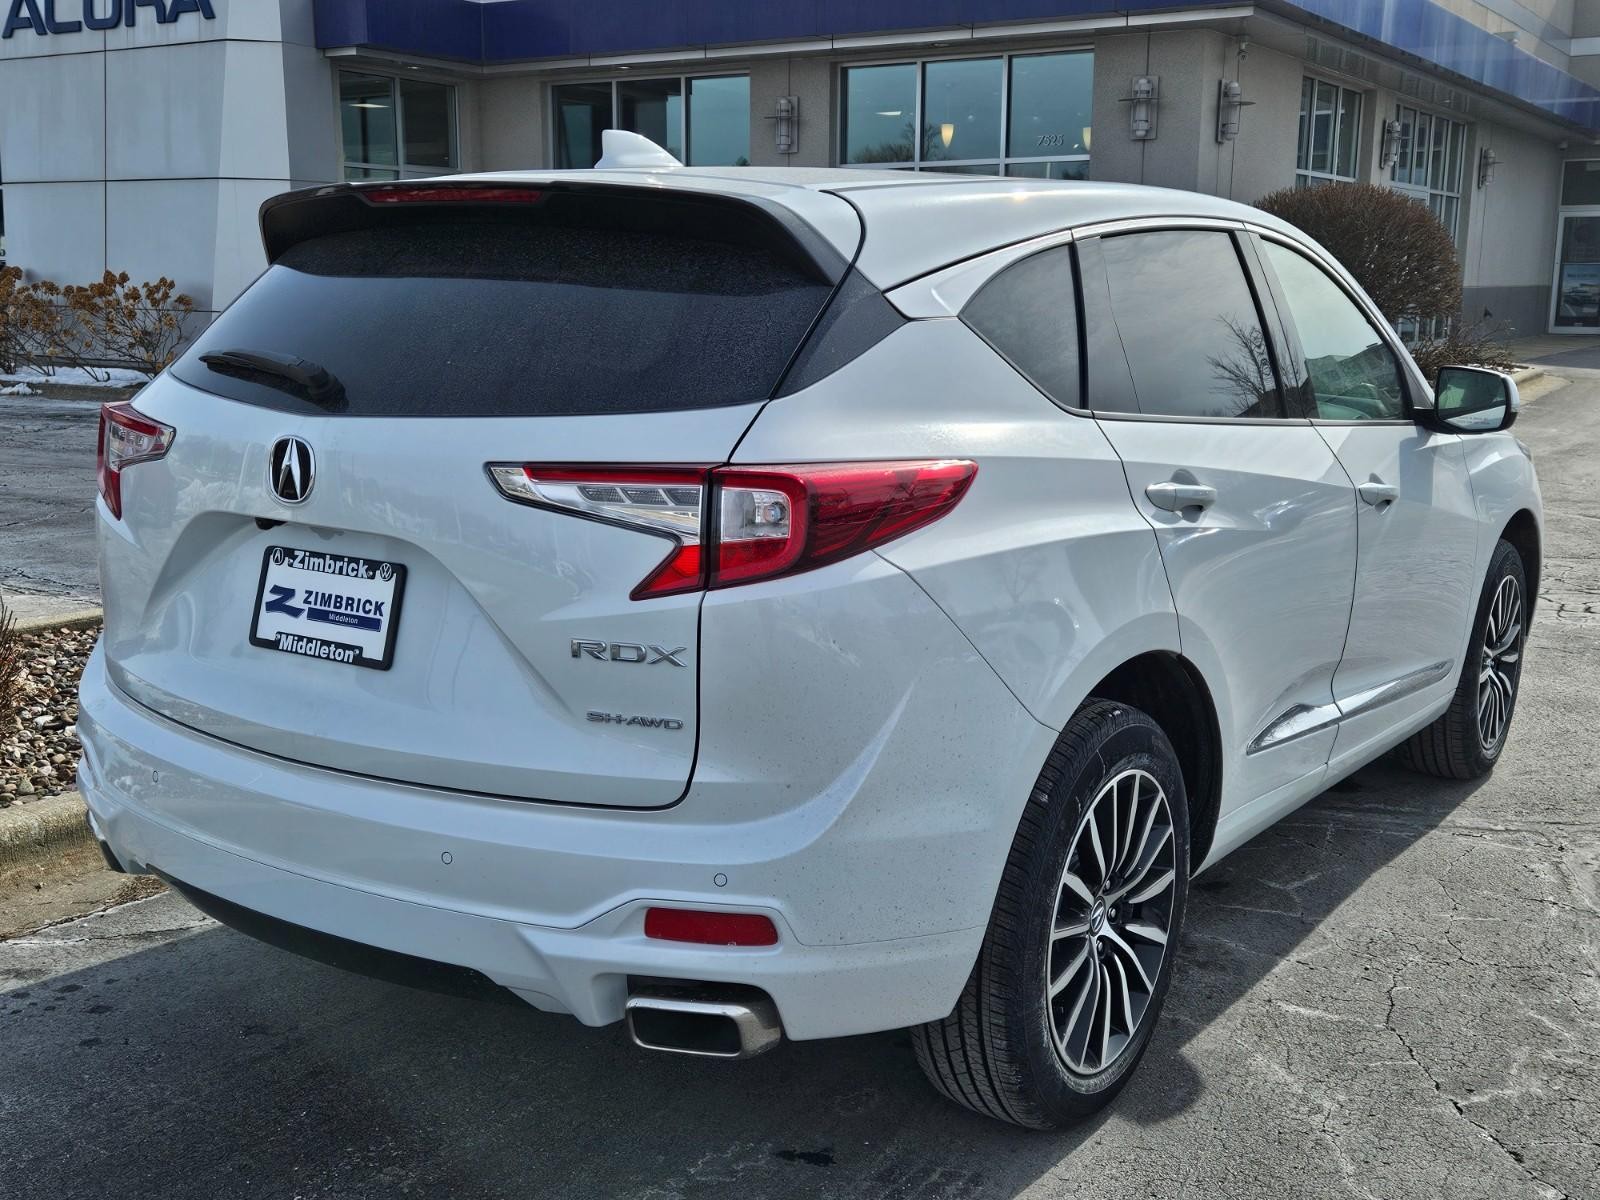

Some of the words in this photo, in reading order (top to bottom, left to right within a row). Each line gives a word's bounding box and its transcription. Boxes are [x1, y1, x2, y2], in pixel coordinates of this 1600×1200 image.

[293, 550, 368, 579] Zimbrick
[303, 589, 385, 617] ZIMBRICK
[329, 613, 358, 625] Middleton
[278, 633, 353, 663] Middleton
[571, 639, 687, 667] RDX
[586, 710, 684, 729] SH-AWD
